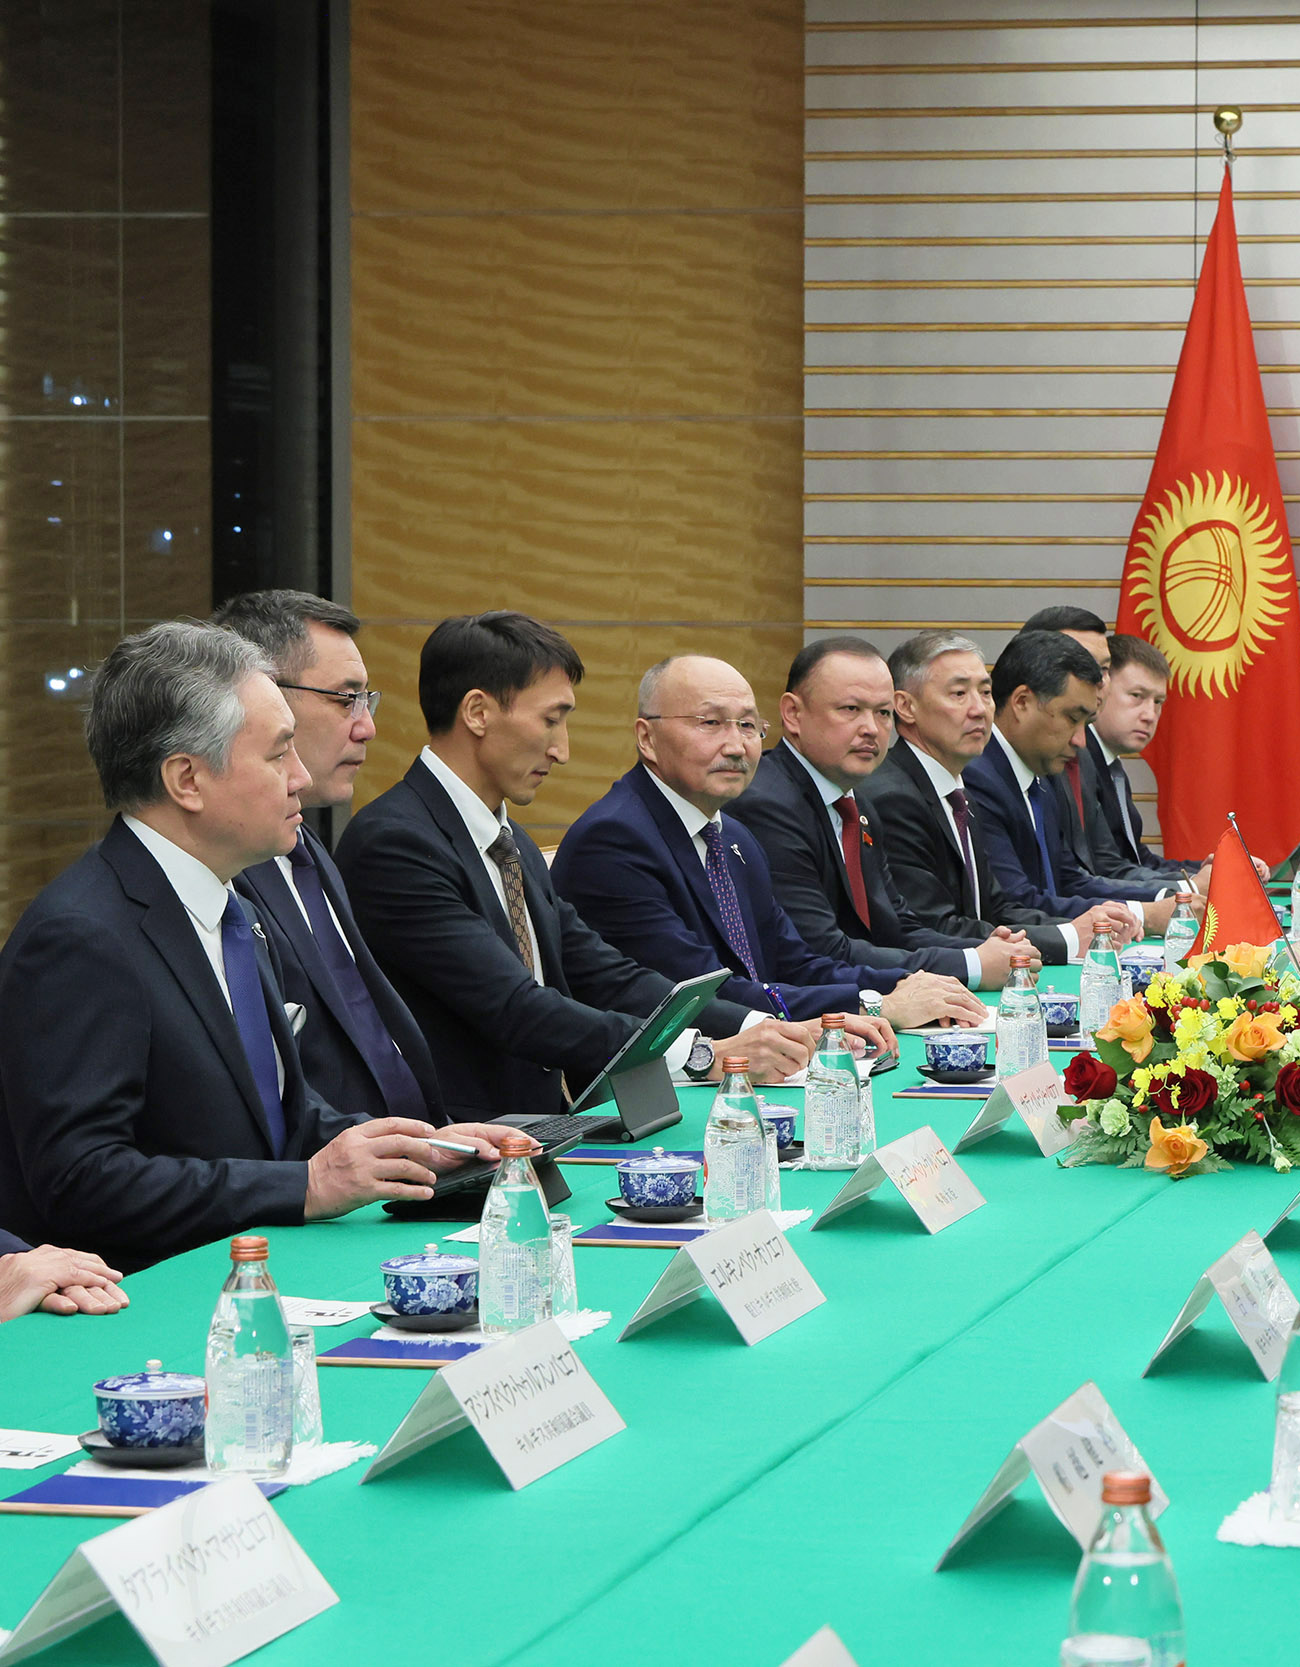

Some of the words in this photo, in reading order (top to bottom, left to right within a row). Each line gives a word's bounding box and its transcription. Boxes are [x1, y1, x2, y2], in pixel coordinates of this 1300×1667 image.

[516, 1401, 595, 1454] キルギス共和国議会議員
